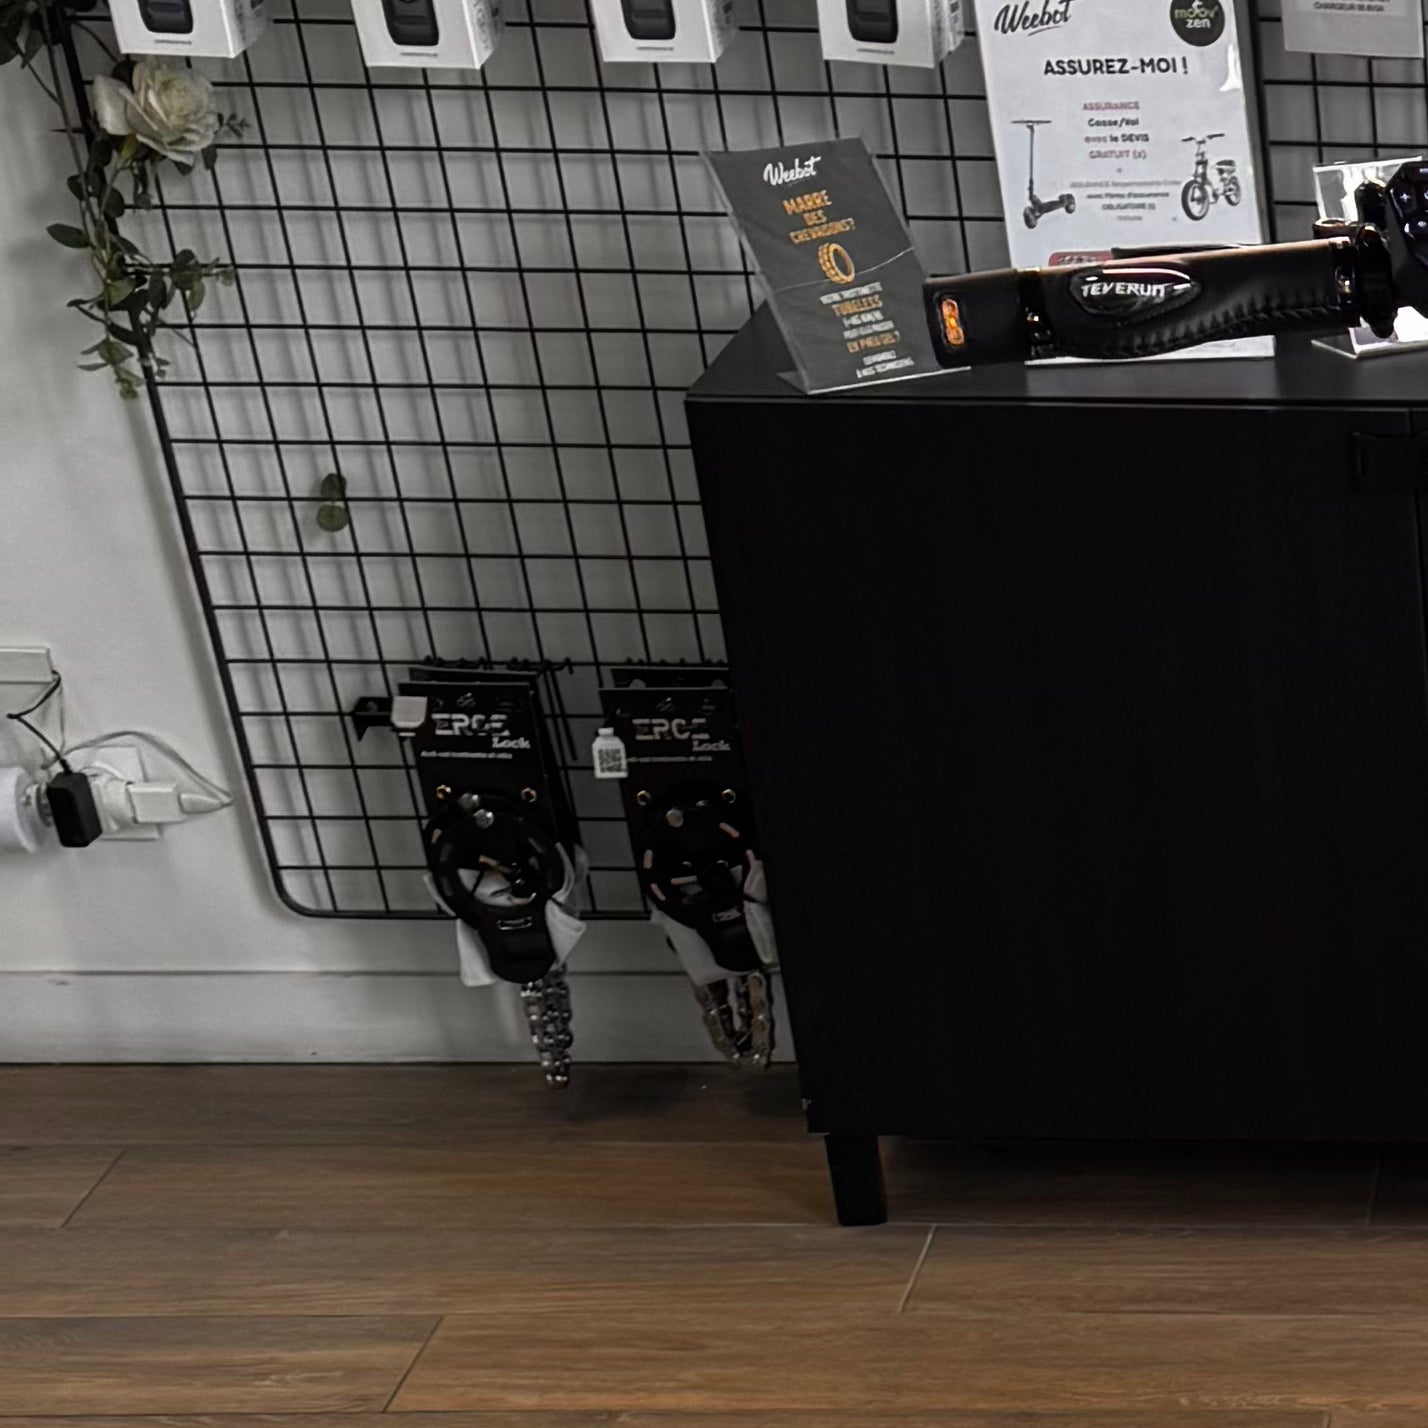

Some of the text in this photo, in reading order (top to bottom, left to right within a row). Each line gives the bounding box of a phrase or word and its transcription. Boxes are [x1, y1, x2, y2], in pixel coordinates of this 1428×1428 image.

[994, 0, 1073, 36] Weebot
[1186, 18, 1211, 29] zen
[1044, 57, 1189, 76] ASSUREZ-MOI !
